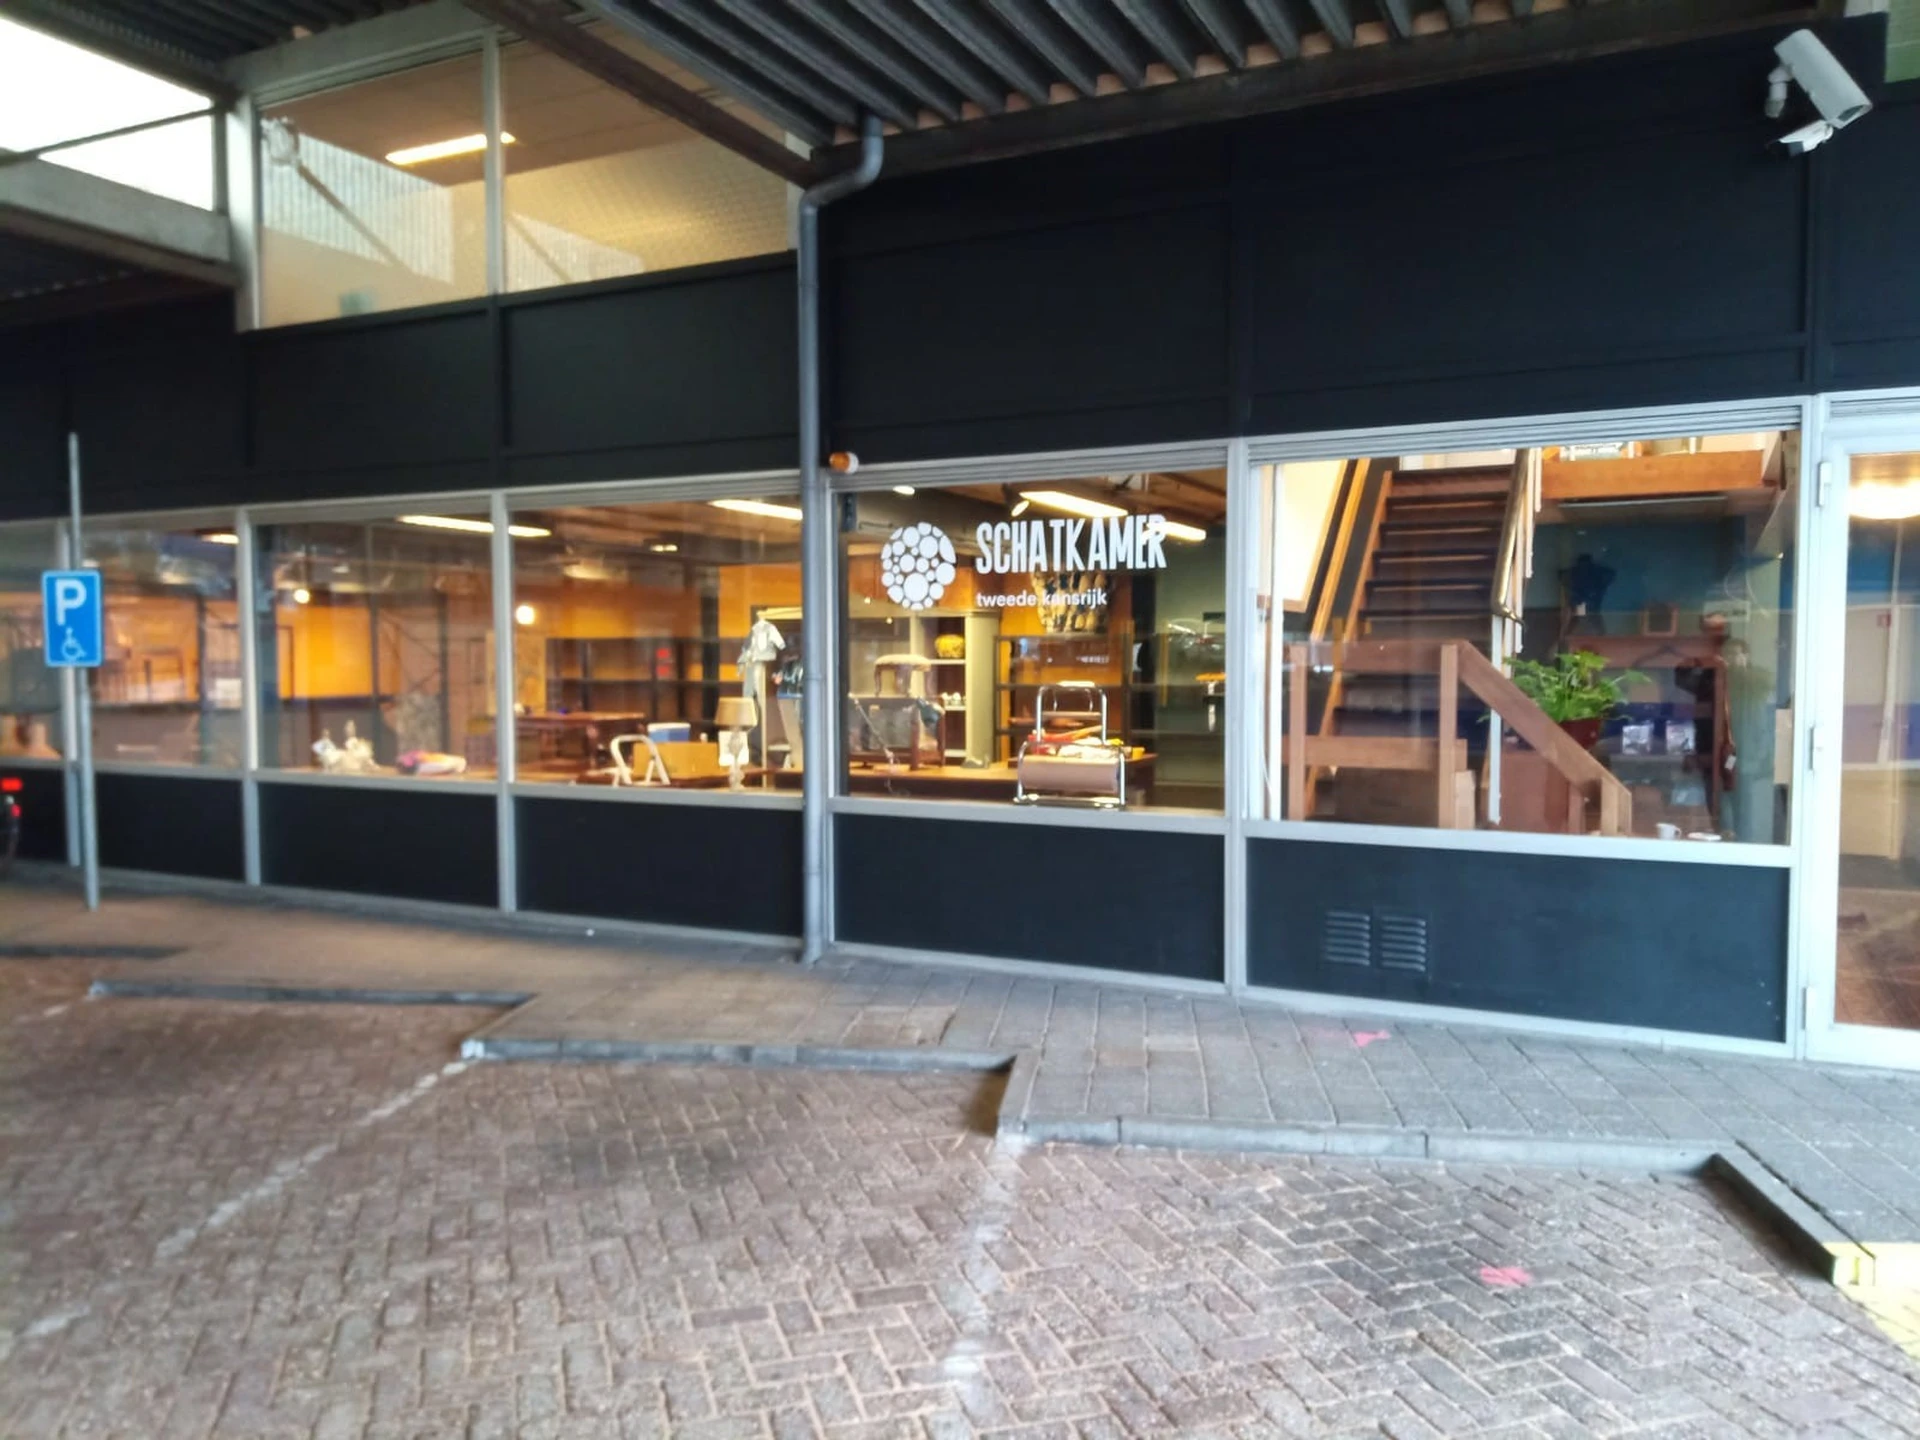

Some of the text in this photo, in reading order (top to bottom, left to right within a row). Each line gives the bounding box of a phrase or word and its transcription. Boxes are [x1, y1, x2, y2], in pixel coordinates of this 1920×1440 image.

[976, 515, 1167, 574] SCHATKAMER
[55, 579, 87, 625] P
[976, 590, 1108, 609] tweede kansrijk
